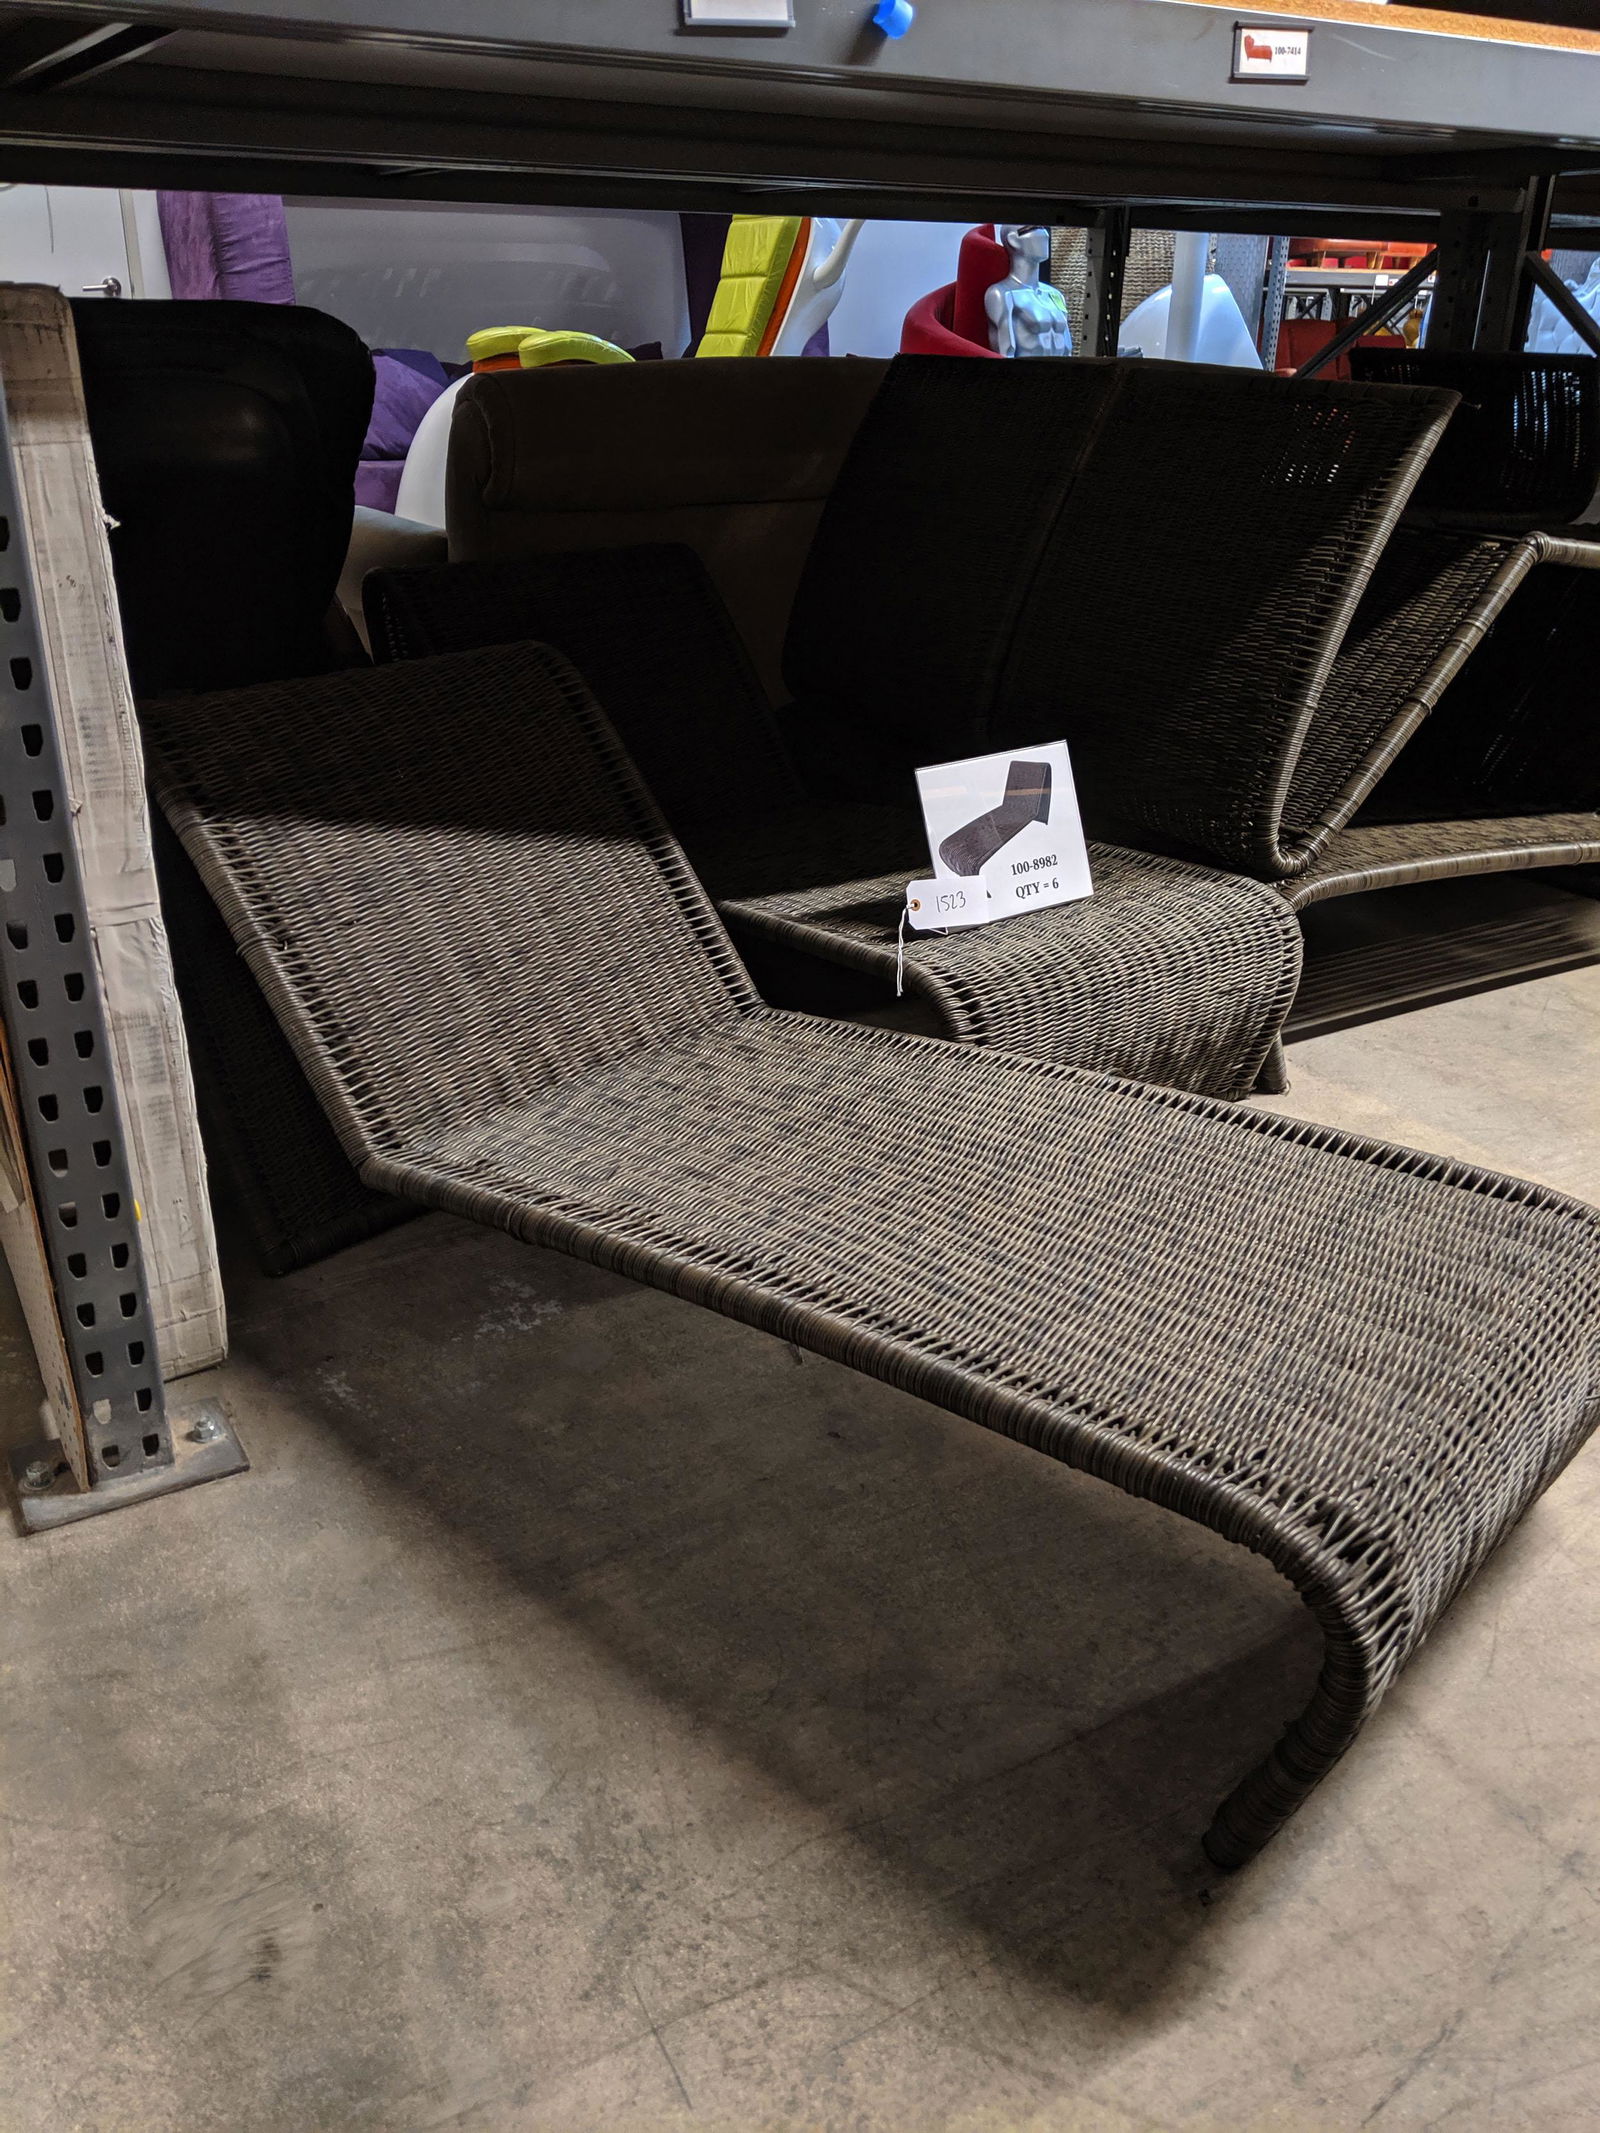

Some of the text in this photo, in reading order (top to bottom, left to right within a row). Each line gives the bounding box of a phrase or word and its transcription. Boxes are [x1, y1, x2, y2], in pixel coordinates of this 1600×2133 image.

[1274, 46, 1302, 56] 100-7414
[1011, 854, 1058, 876] 100-8982
[1015, 881, 1040, 899] QTY
[1052, 877, 1059, 889] 6
[936, 890, 966, 912] 1523
